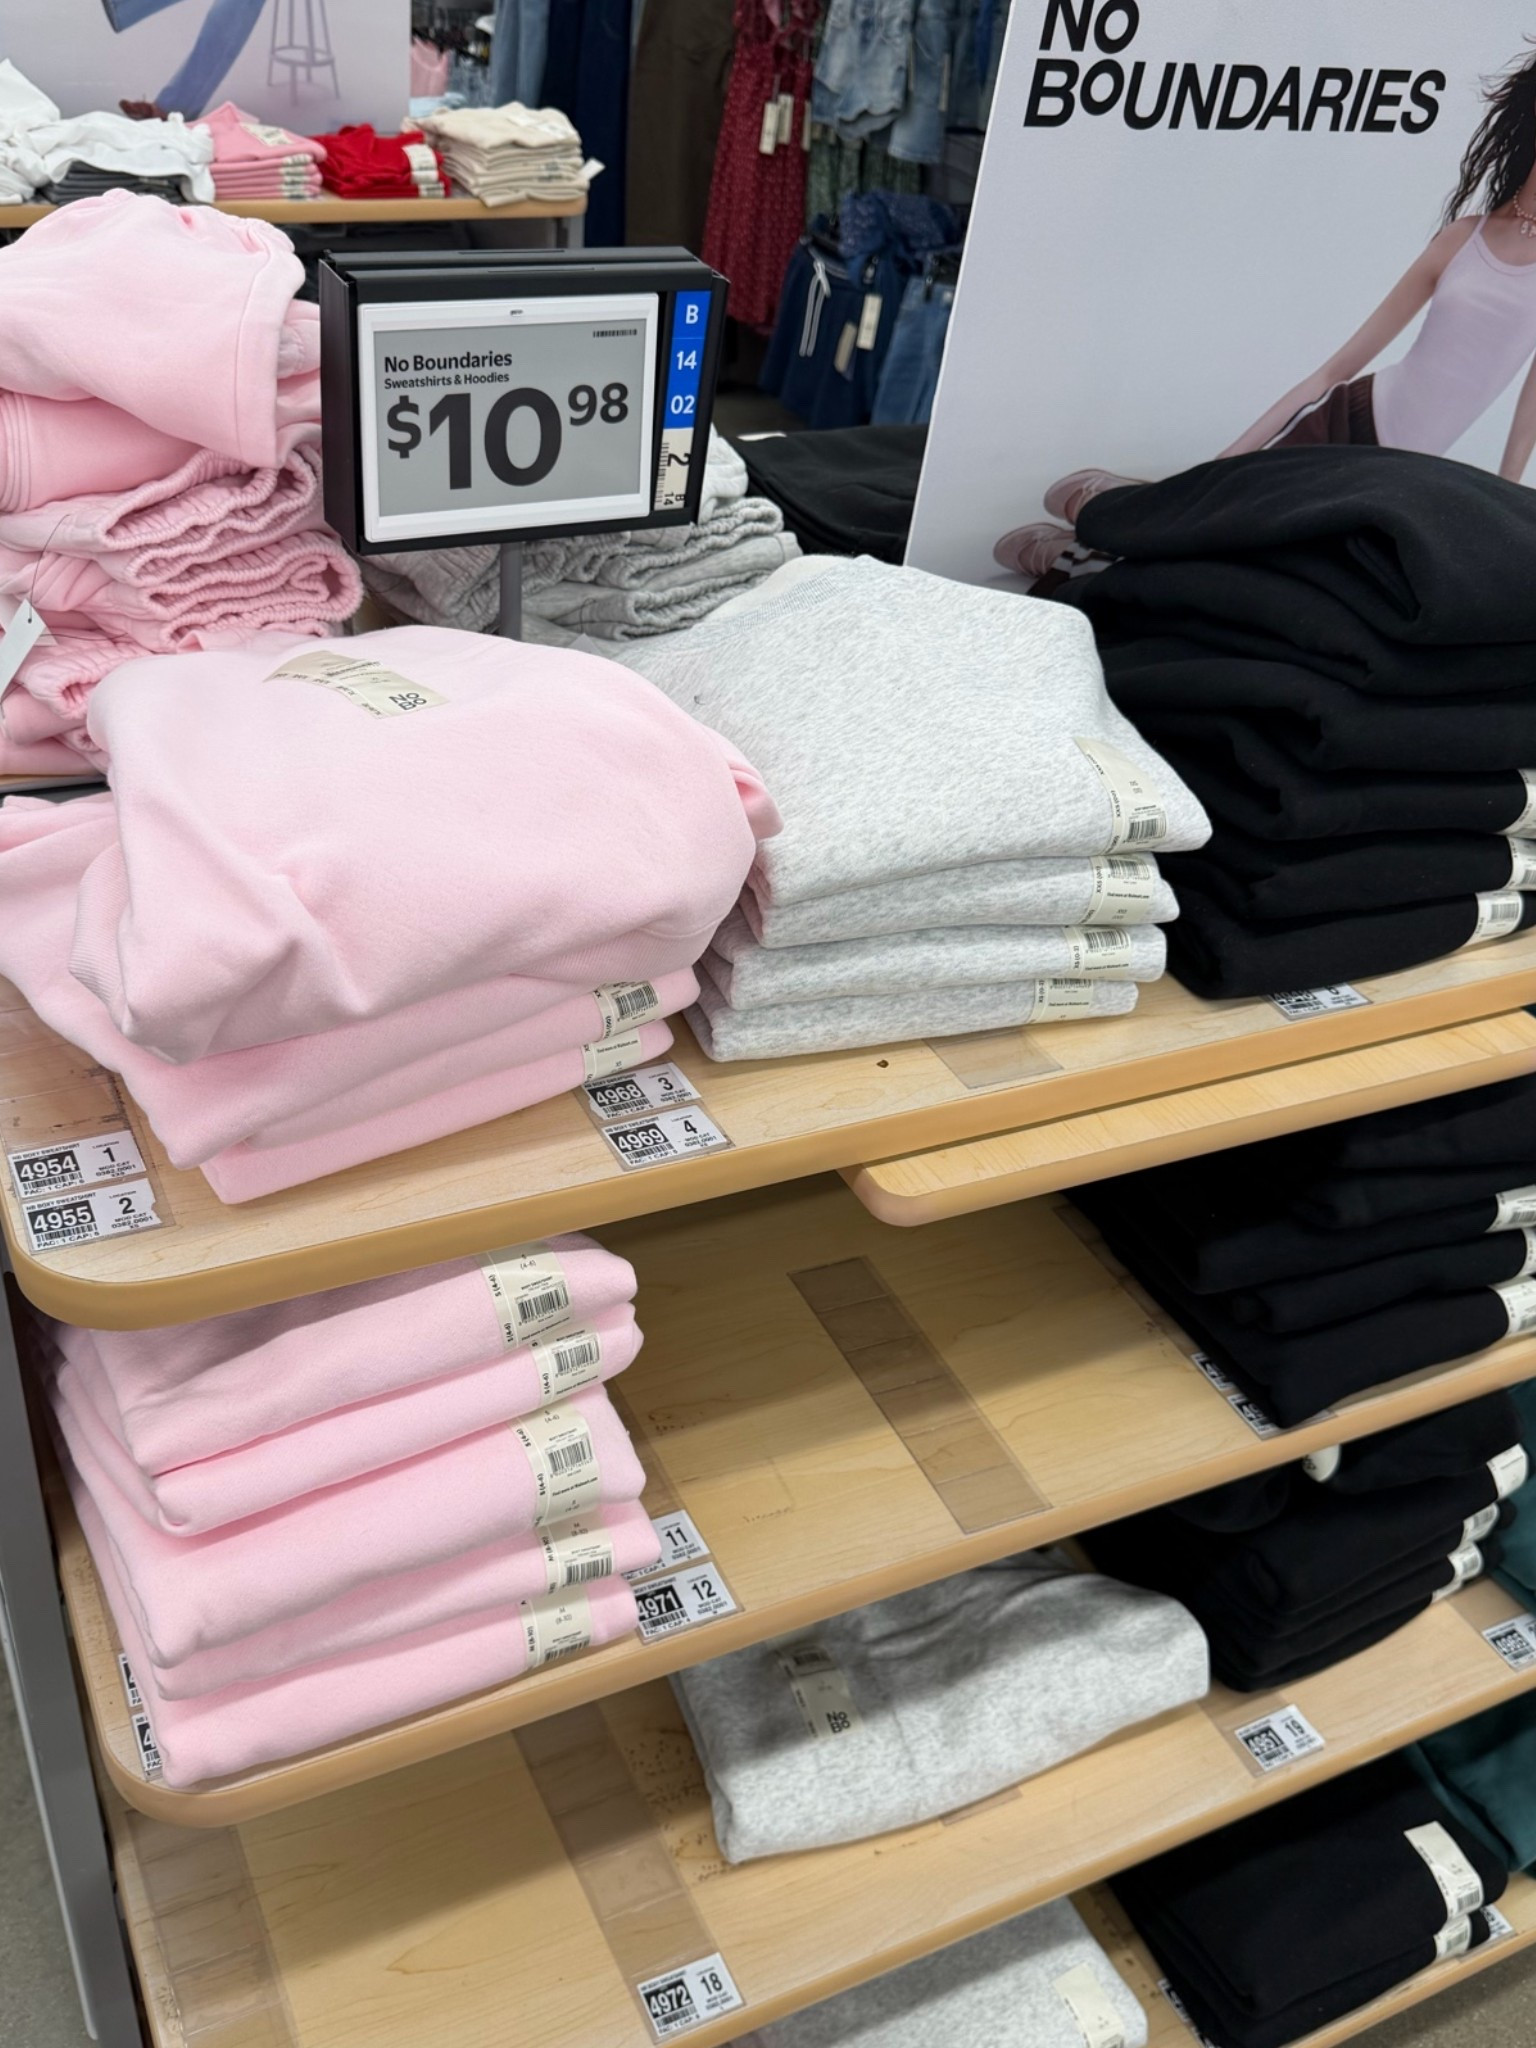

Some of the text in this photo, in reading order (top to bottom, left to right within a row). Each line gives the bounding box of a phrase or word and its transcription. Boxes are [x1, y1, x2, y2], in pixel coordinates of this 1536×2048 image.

[1039, 0, 1139, 54] NO
[1024, 58, 1446, 134] BOUNDARIES
[685, 304, 699, 324] B
[384, 350, 513, 373] No Boundaries
[677, 350, 697, 370] 14
[384, 371, 510, 390] Sweatshirts & Hoodies
[671, 394, 695, 415] 02
[596, 1084, 642, 1105] 4968
[658, 1077, 673, 1091] 3
[683, 1120, 698, 1134] 4
[618, 1128, 665, 1151] 4969
[103, 1146, 116, 1162] 1
[20, 1154, 77, 1180] 4954
[118, 1196, 136, 1215] 2
[34, 1205, 92, 1232] 4955
[665, 1526, 688, 1546] 11
[691, 1579, 717, 1601] 12
[638, 1590, 679, 1619] 4971
[1285, 1719, 1305, 1738] 19
[700, 1971, 723, 1996] 18
[649, 1984, 691, 2017] 4972
